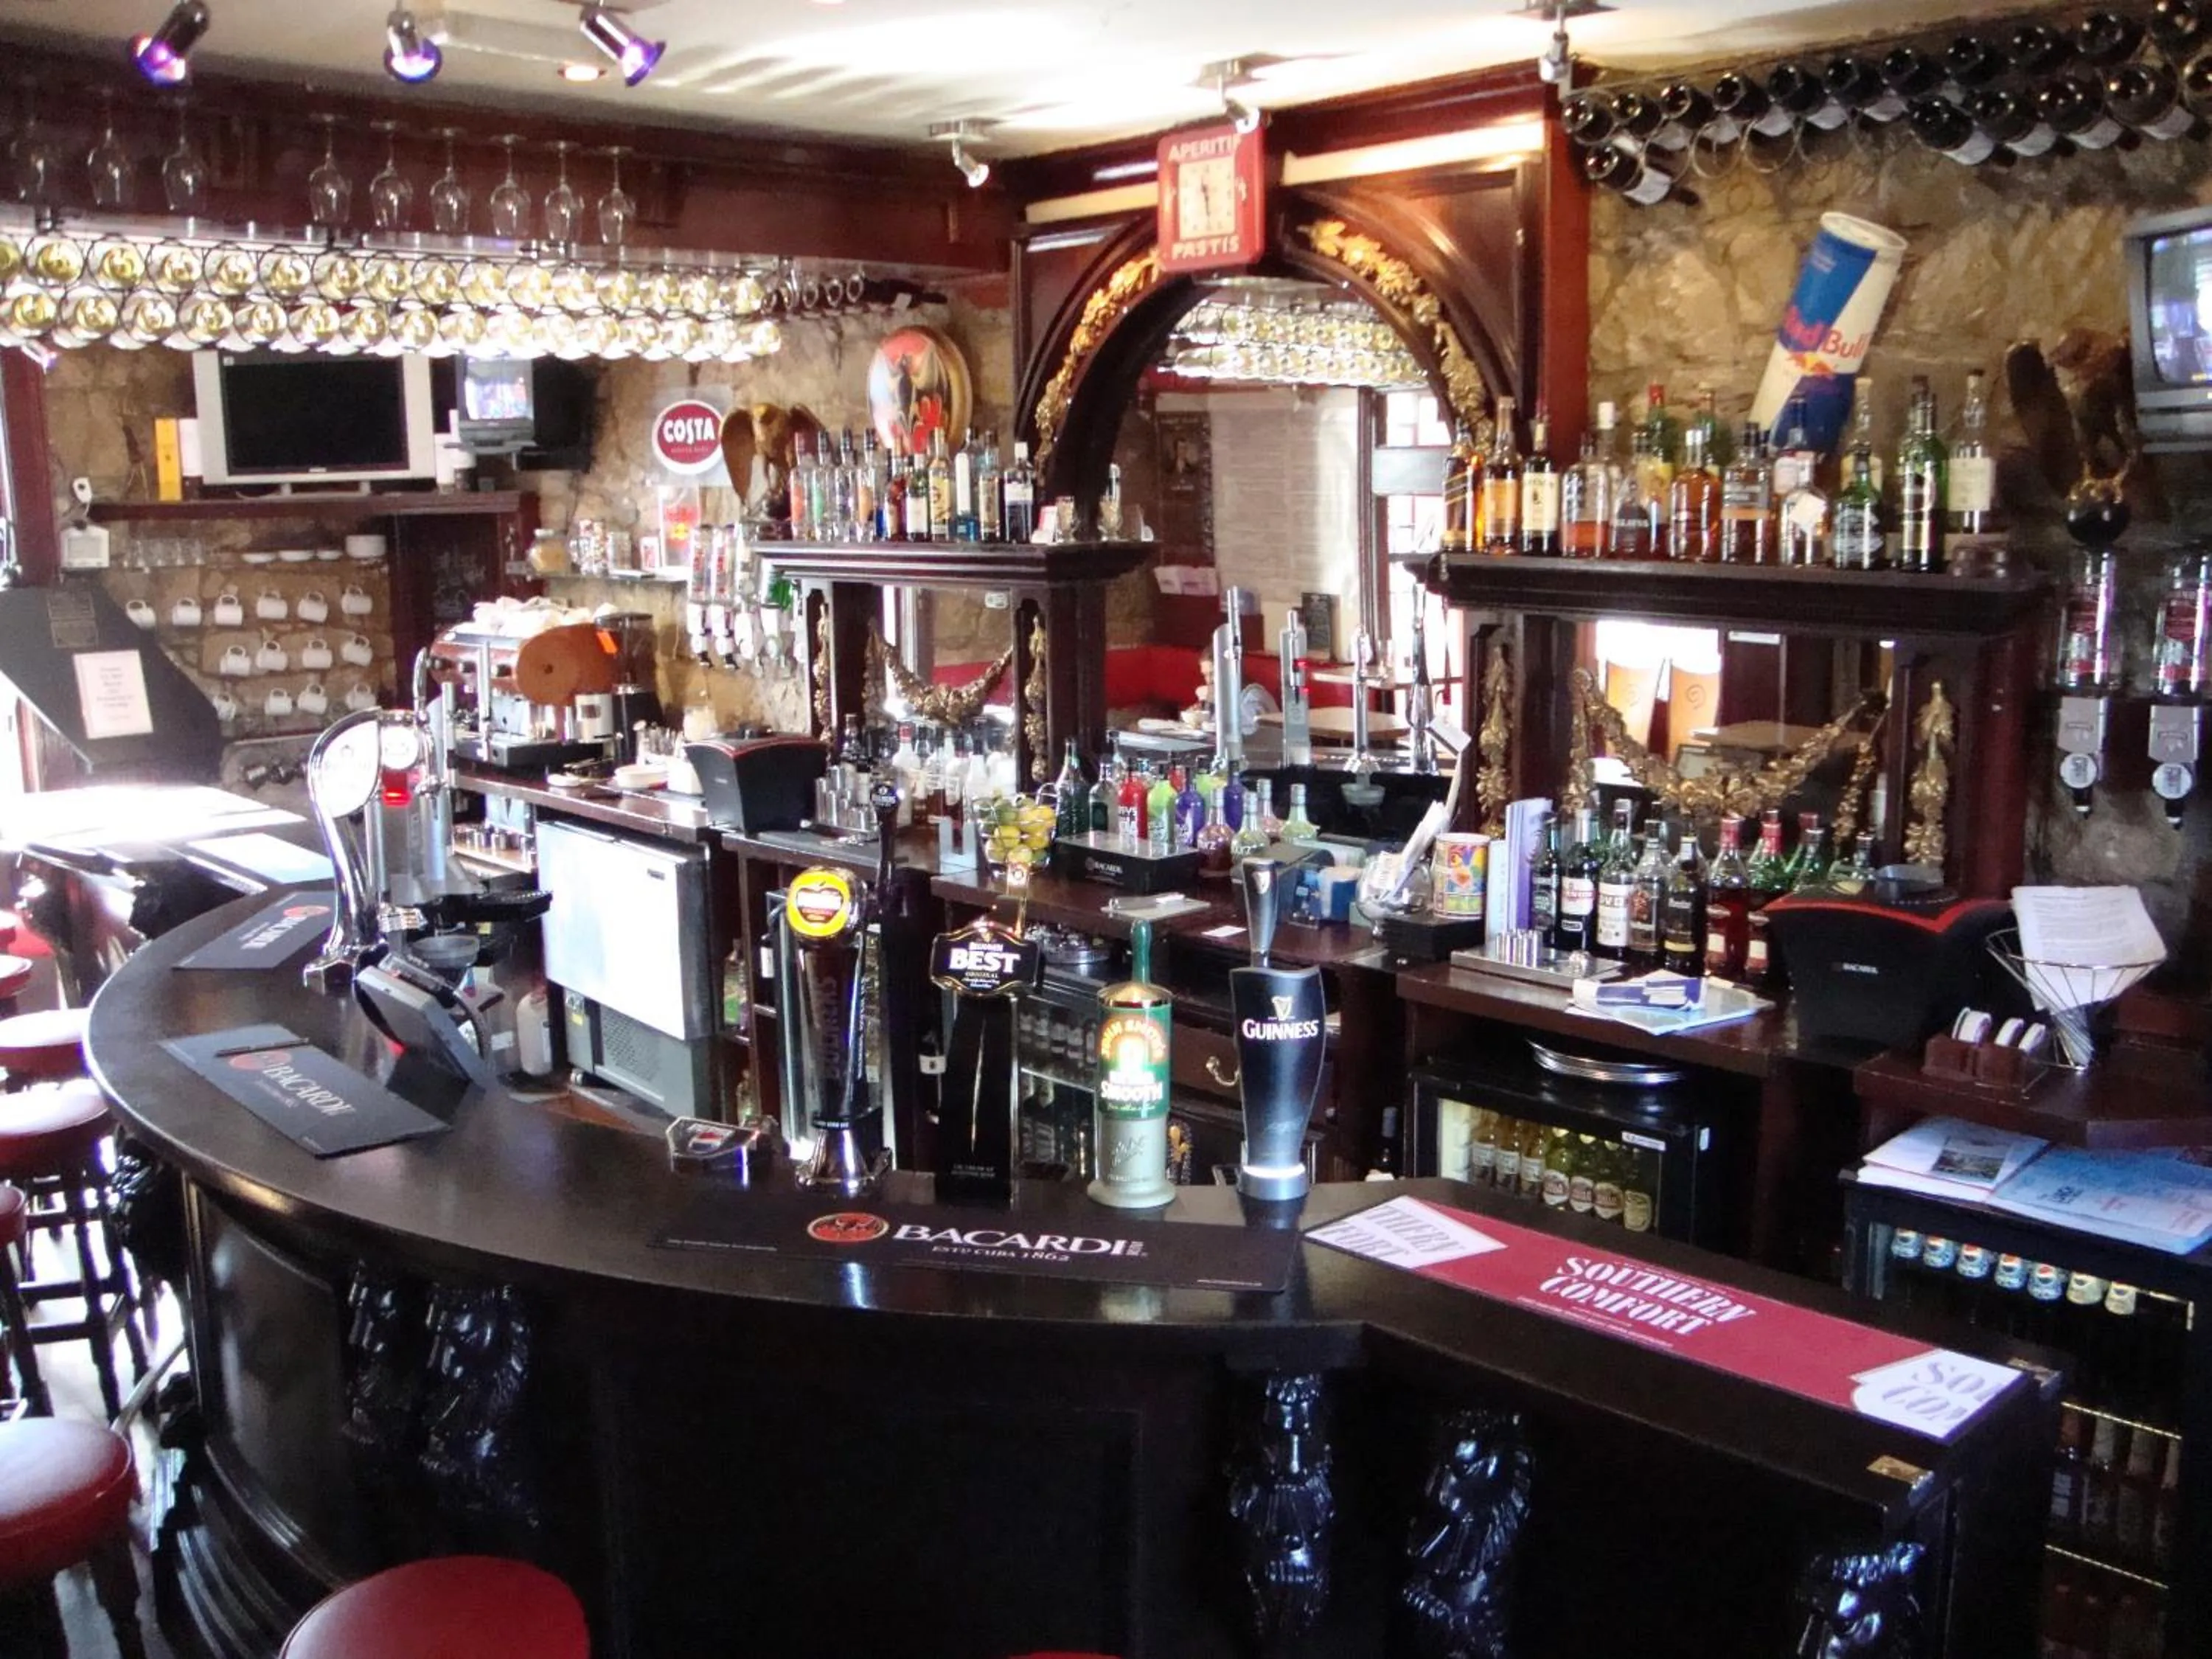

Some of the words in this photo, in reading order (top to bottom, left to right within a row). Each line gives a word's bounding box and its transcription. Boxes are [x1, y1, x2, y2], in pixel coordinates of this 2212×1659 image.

[1168, 133, 1242, 162] APERITIF
[1172, 235, 1239, 260] PASTIS
[1820, 329, 1873, 358] Bull
[663, 417, 716, 445] COSTA
[948, 947, 1021, 973] BEST
[1242, 1018, 1319, 1040] GUINNESS
[1100, 1080, 1163, 1101] SMOOTH
[893, 1225, 1127, 1256] BACARDI
[1556, 1256, 1756, 1322] SOUTHERN
[1539, 1276, 1712, 1335] COMFORT
